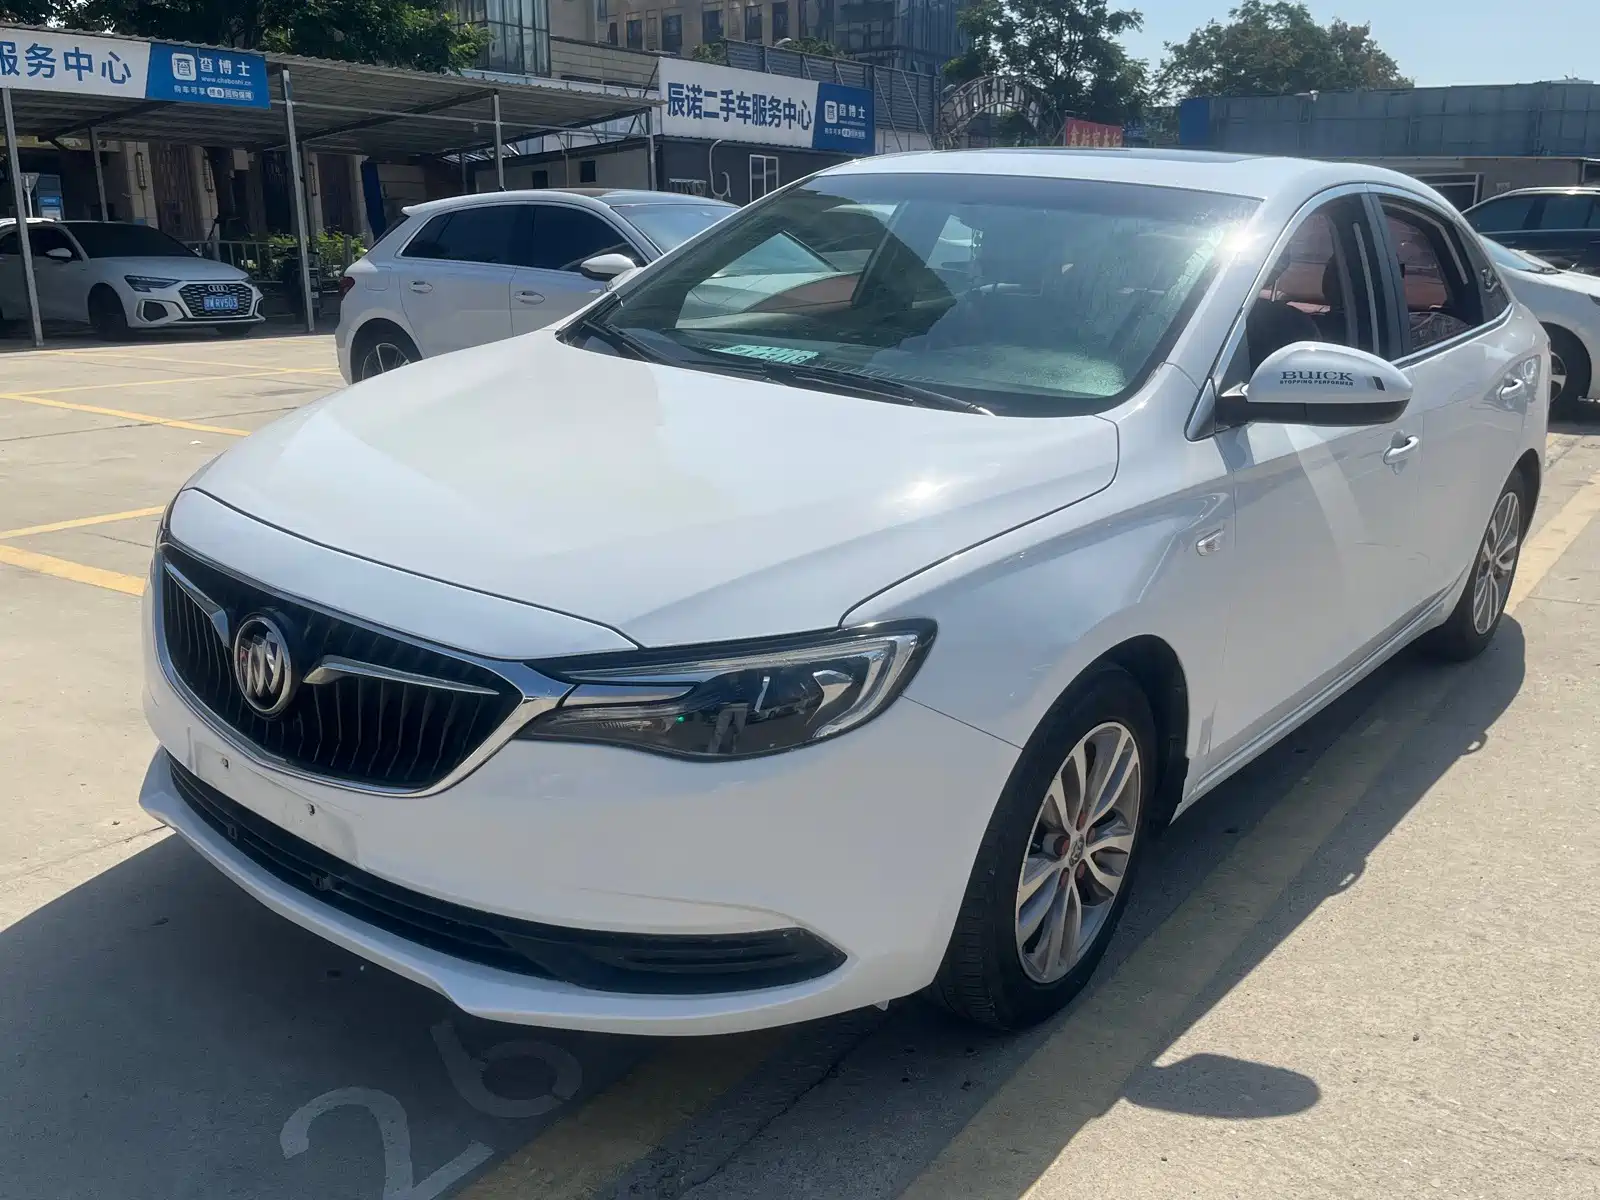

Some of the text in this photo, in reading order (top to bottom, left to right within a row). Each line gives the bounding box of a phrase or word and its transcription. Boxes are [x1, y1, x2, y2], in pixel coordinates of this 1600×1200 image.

[199, 57, 250, 77] 查博士
[667, 82, 812, 131] 辰诺二手车服务中心
[1281, 371, 1354, 382] BUICK
